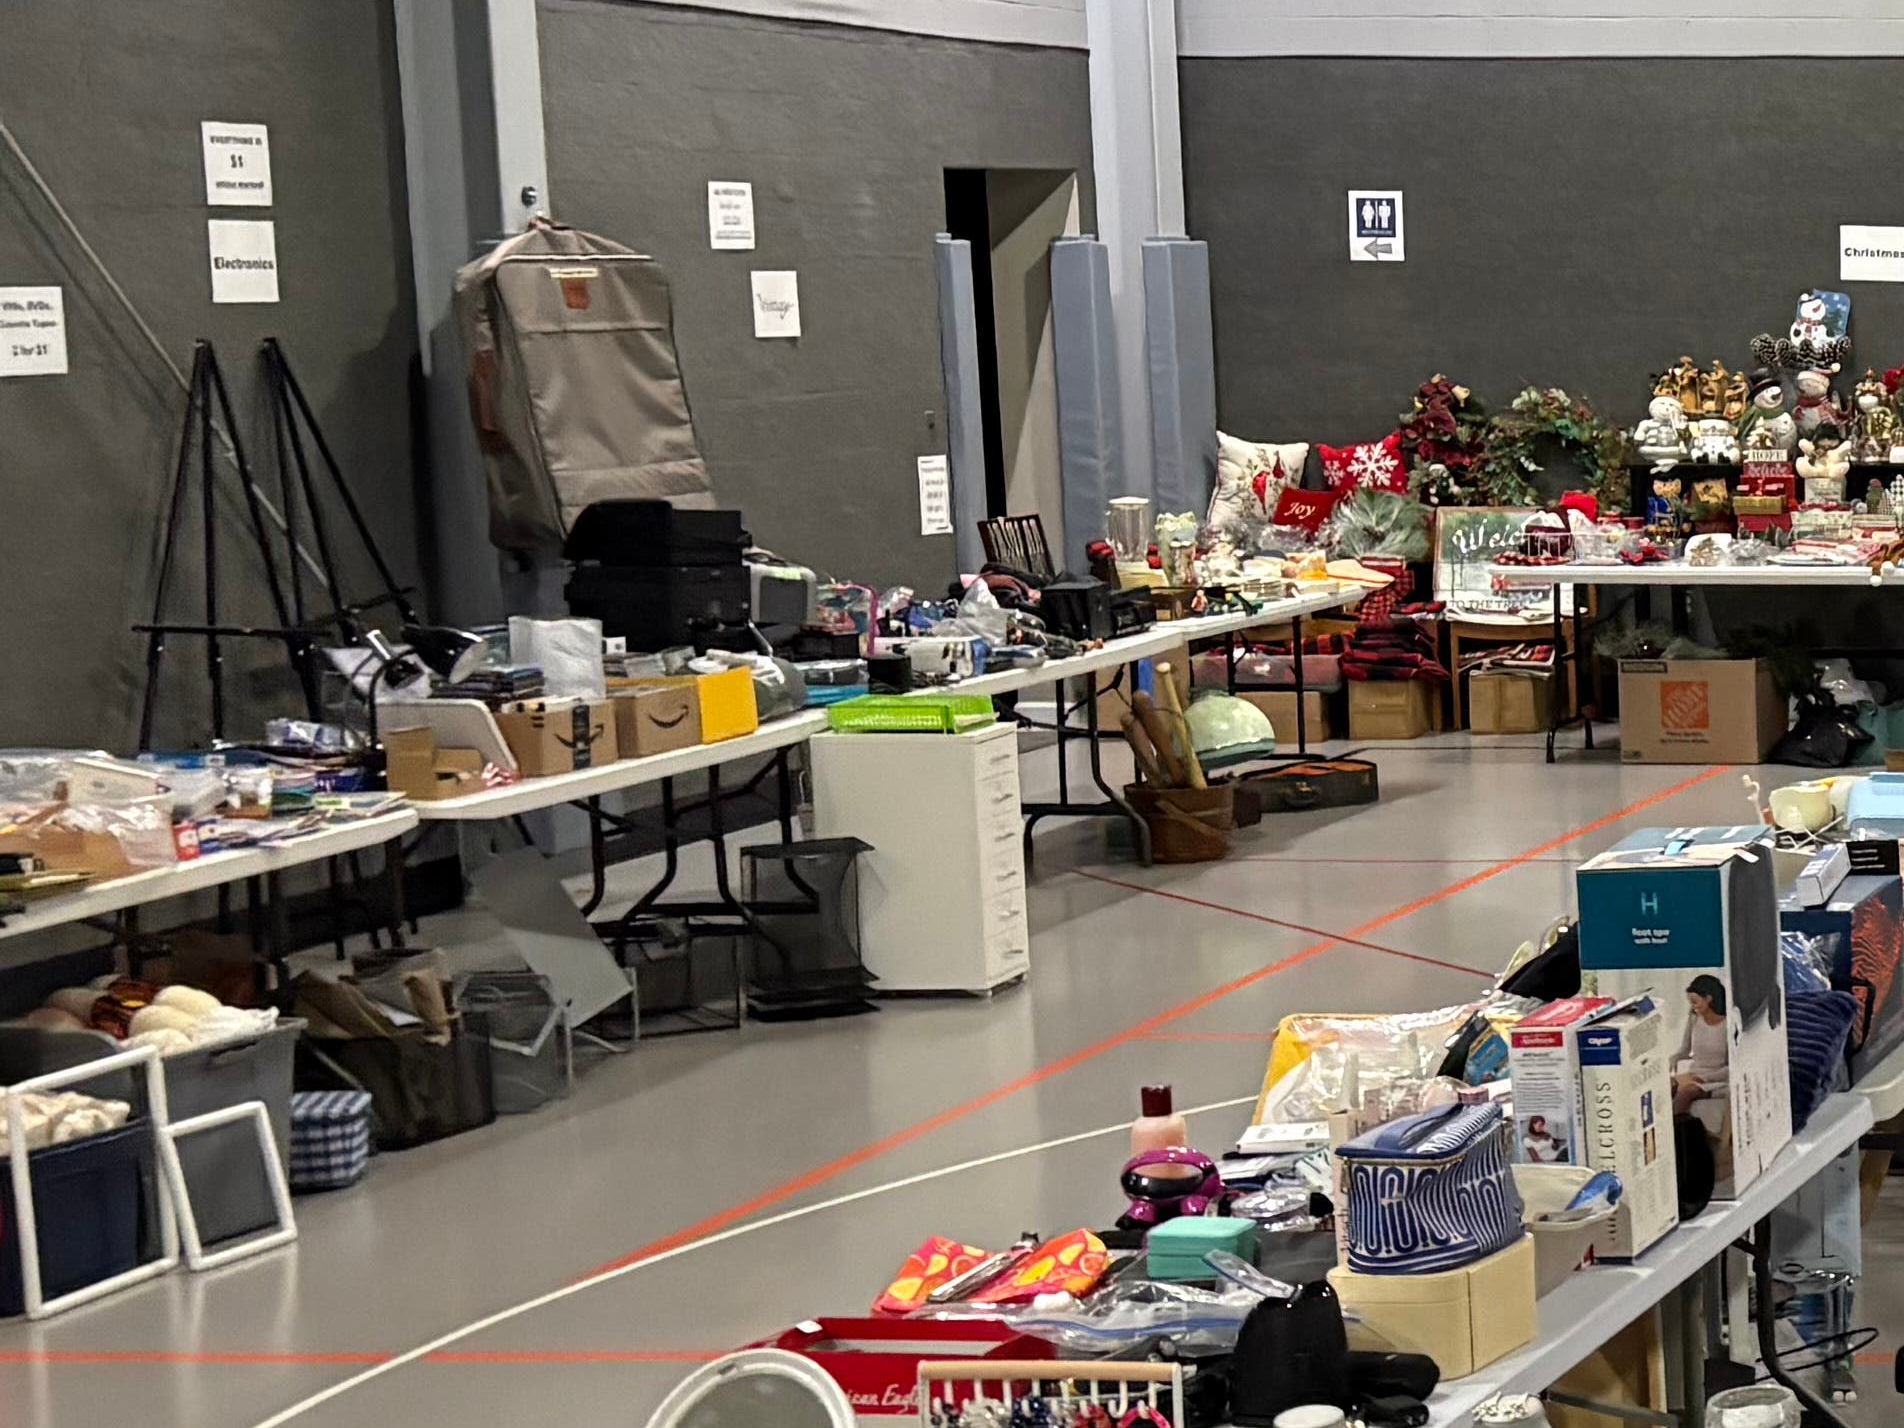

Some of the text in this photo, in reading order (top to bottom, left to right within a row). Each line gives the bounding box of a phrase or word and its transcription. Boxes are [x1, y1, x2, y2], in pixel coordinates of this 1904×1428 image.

[213, 256, 274, 270] Electronics
[1283, 502, 1316, 519] Joy
[1468, 599, 1493, 608] THE
[1641, 892, 1658, 916] H
